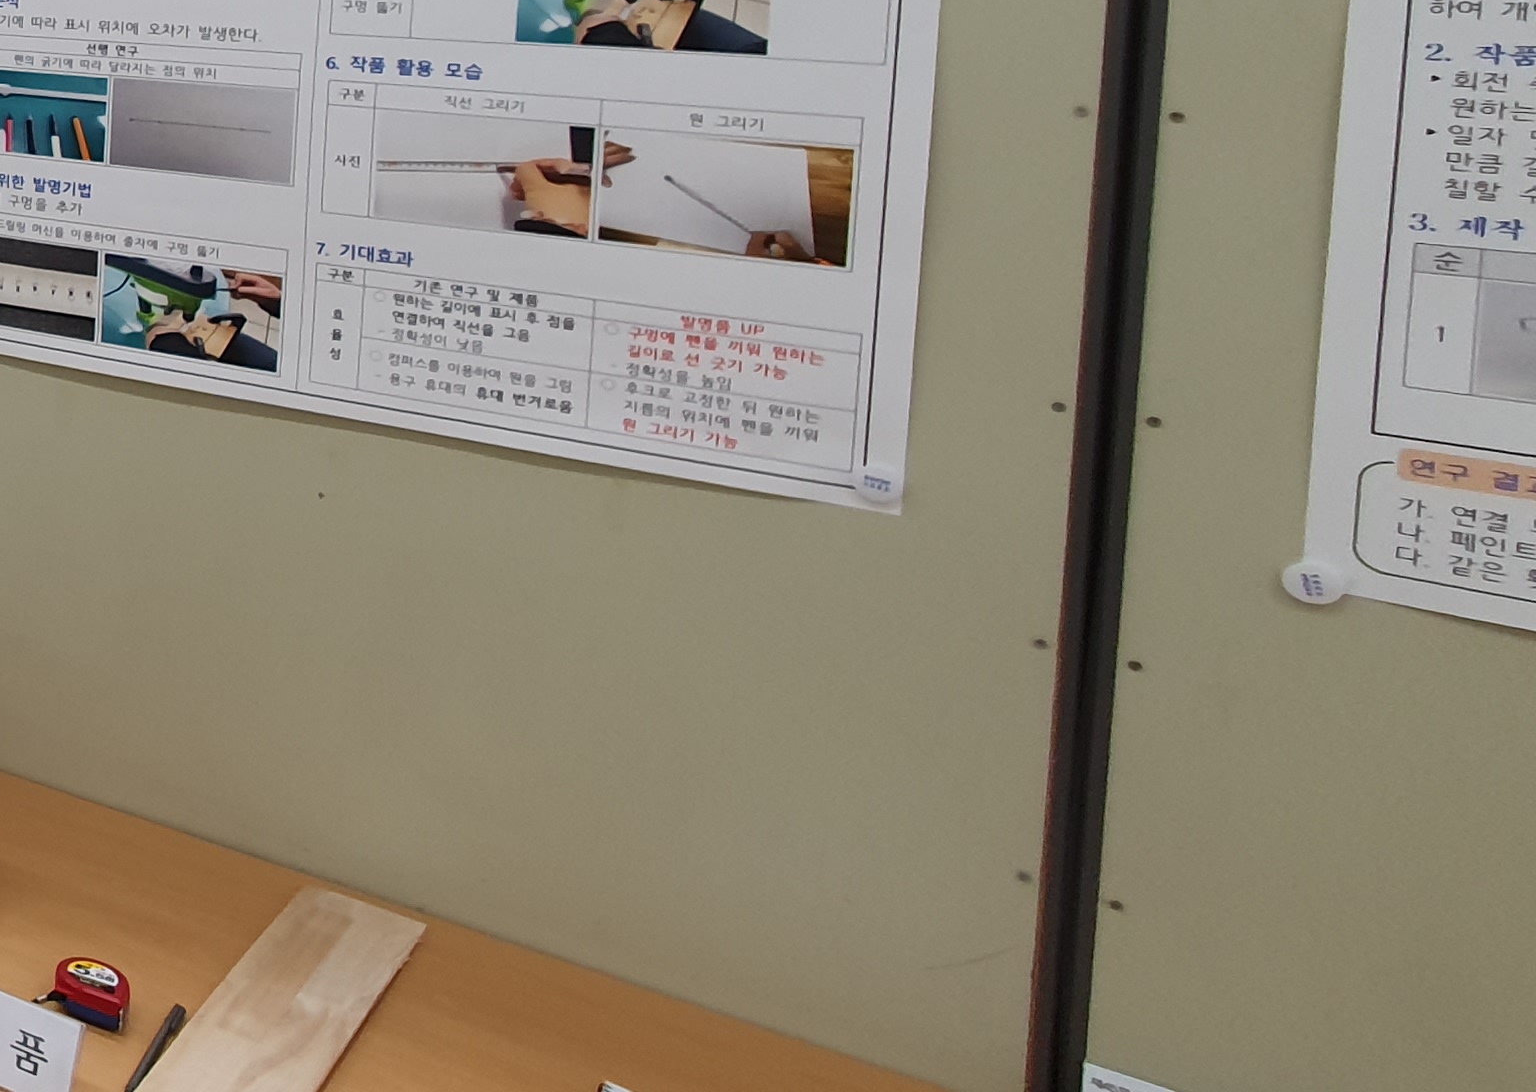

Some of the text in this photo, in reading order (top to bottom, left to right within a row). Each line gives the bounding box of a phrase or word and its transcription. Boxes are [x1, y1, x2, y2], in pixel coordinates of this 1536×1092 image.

[1429, 0, 1483, 20] 하여
[1424, 43, 1451, 62] 2.
[325, 55, 483, 81] 6. 작품 활용 모습
[1453, 71, 1509, 94] 회전
[1447, 124, 1508, 147] 일자
[1445, 151, 1503, 175] 만큼
[32, 177, 92, 199] 발명기법
[1444, 178, 1502, 202] 칠할
[8, 194, 47, 212] 구멍을
[55, 200, 83, 217] 추가
[1408, 213, 1525, 240] 3. 제작
[315, 241, 414, 268] 7. 기대효과
[1433, 252, 1464, 272] 순
[1435, 326, 1445, 343] 1
[1410, 458, 1469, 479] 연구
[1399, 497, 1509, 534] 가. 연결
[1394, 546, 1509, 583] 다. 같은
[9, 1028, 49, 1077] 품
